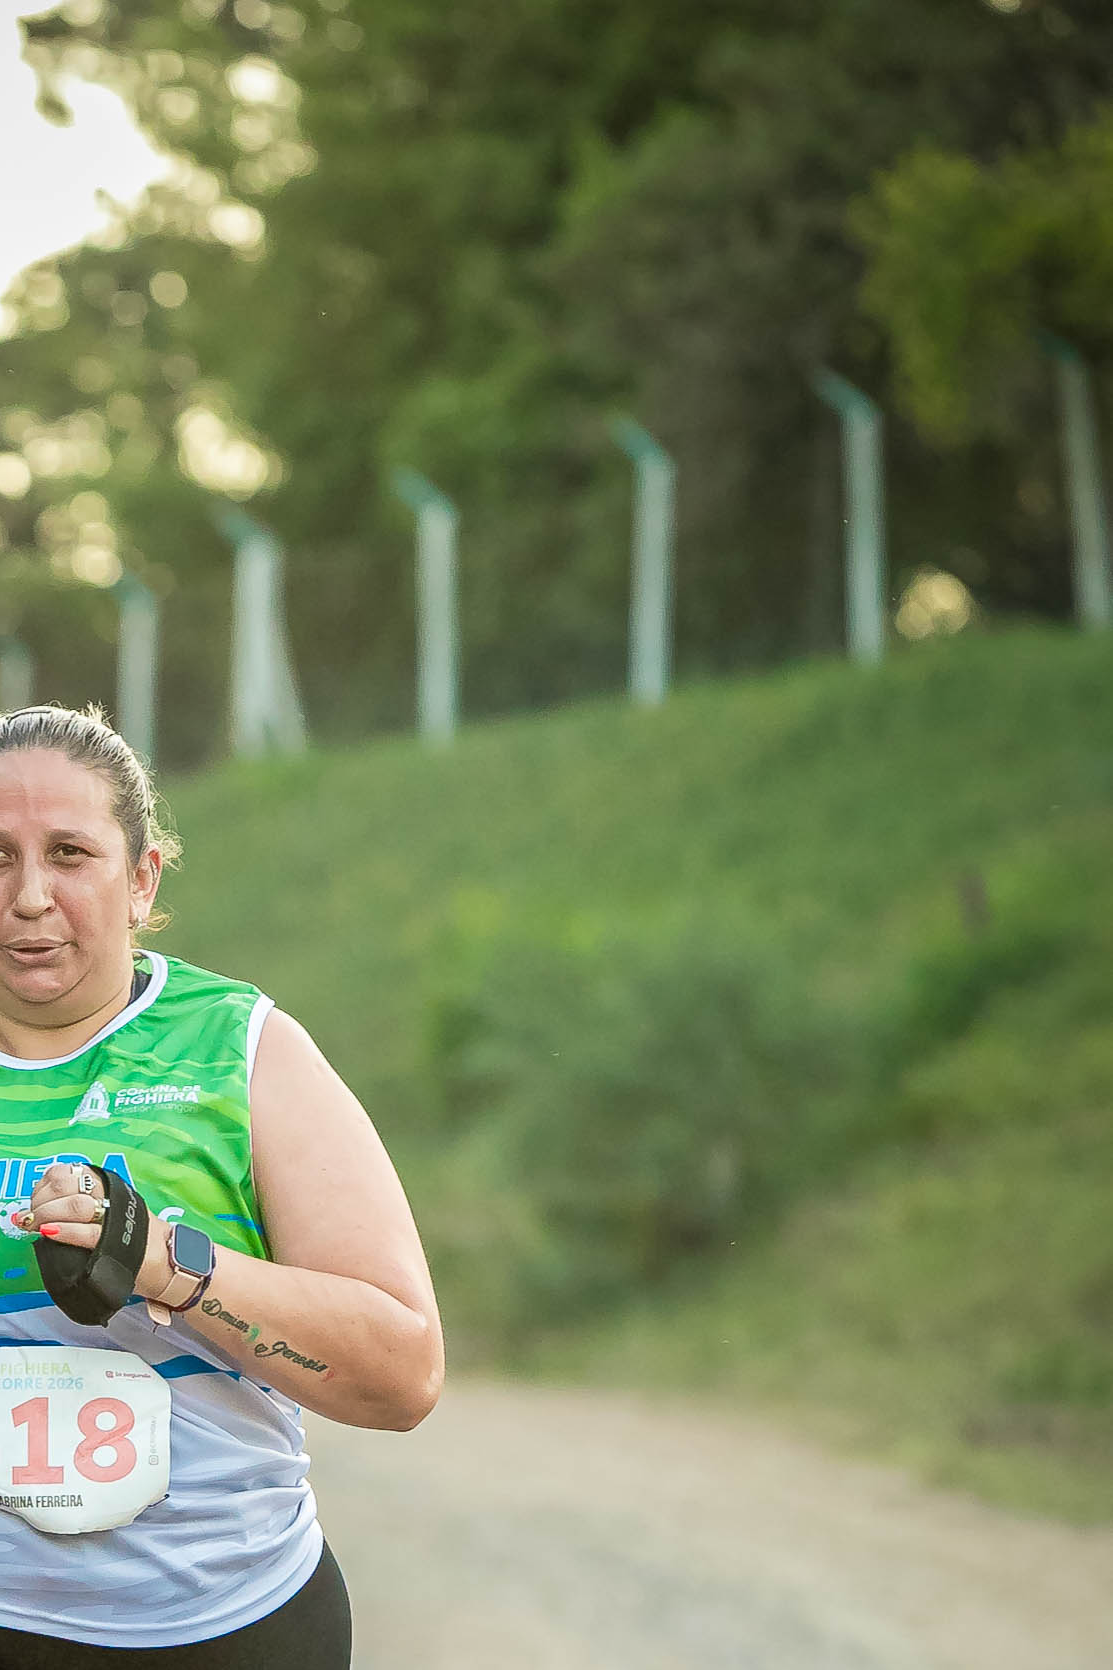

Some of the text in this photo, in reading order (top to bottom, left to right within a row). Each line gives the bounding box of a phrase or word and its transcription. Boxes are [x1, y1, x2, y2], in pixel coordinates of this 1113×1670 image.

[114, 1091, 199, 1107] FIGHIERA
[0, 1362, 71, 1376] FIGHIERA
[48, 1377, 84, 1391] 2026
[36, 1495, 84, 1508] FERREIRA
